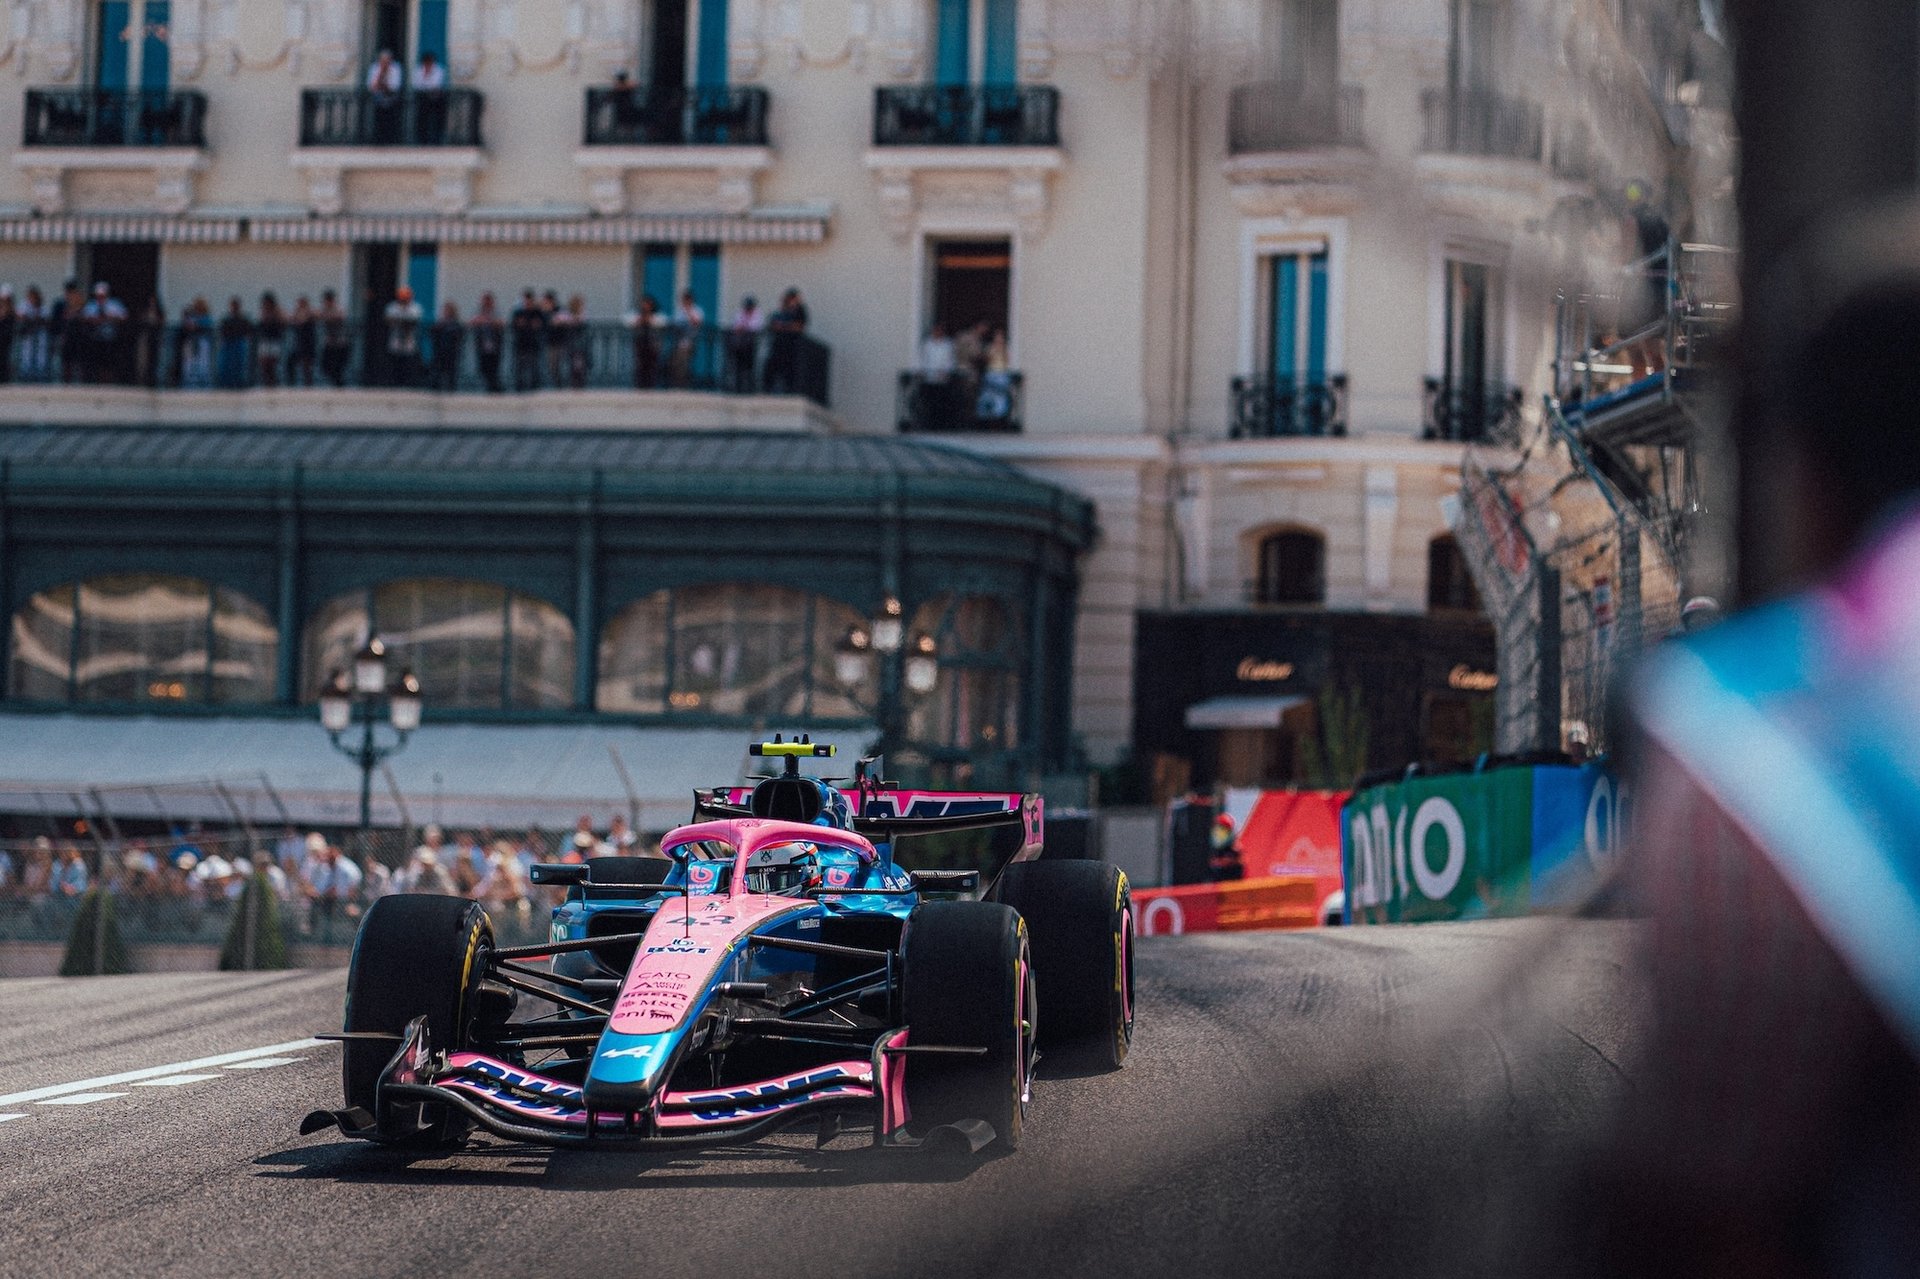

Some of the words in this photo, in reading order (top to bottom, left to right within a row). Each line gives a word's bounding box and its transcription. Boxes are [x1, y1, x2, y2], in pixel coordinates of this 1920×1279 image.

[666, 915, 735, 926] 43
[638, 972, 691, 980] CATO
[640, 1000, 684, 1010] MSC
[614, 1010, 646, 1019] eni
